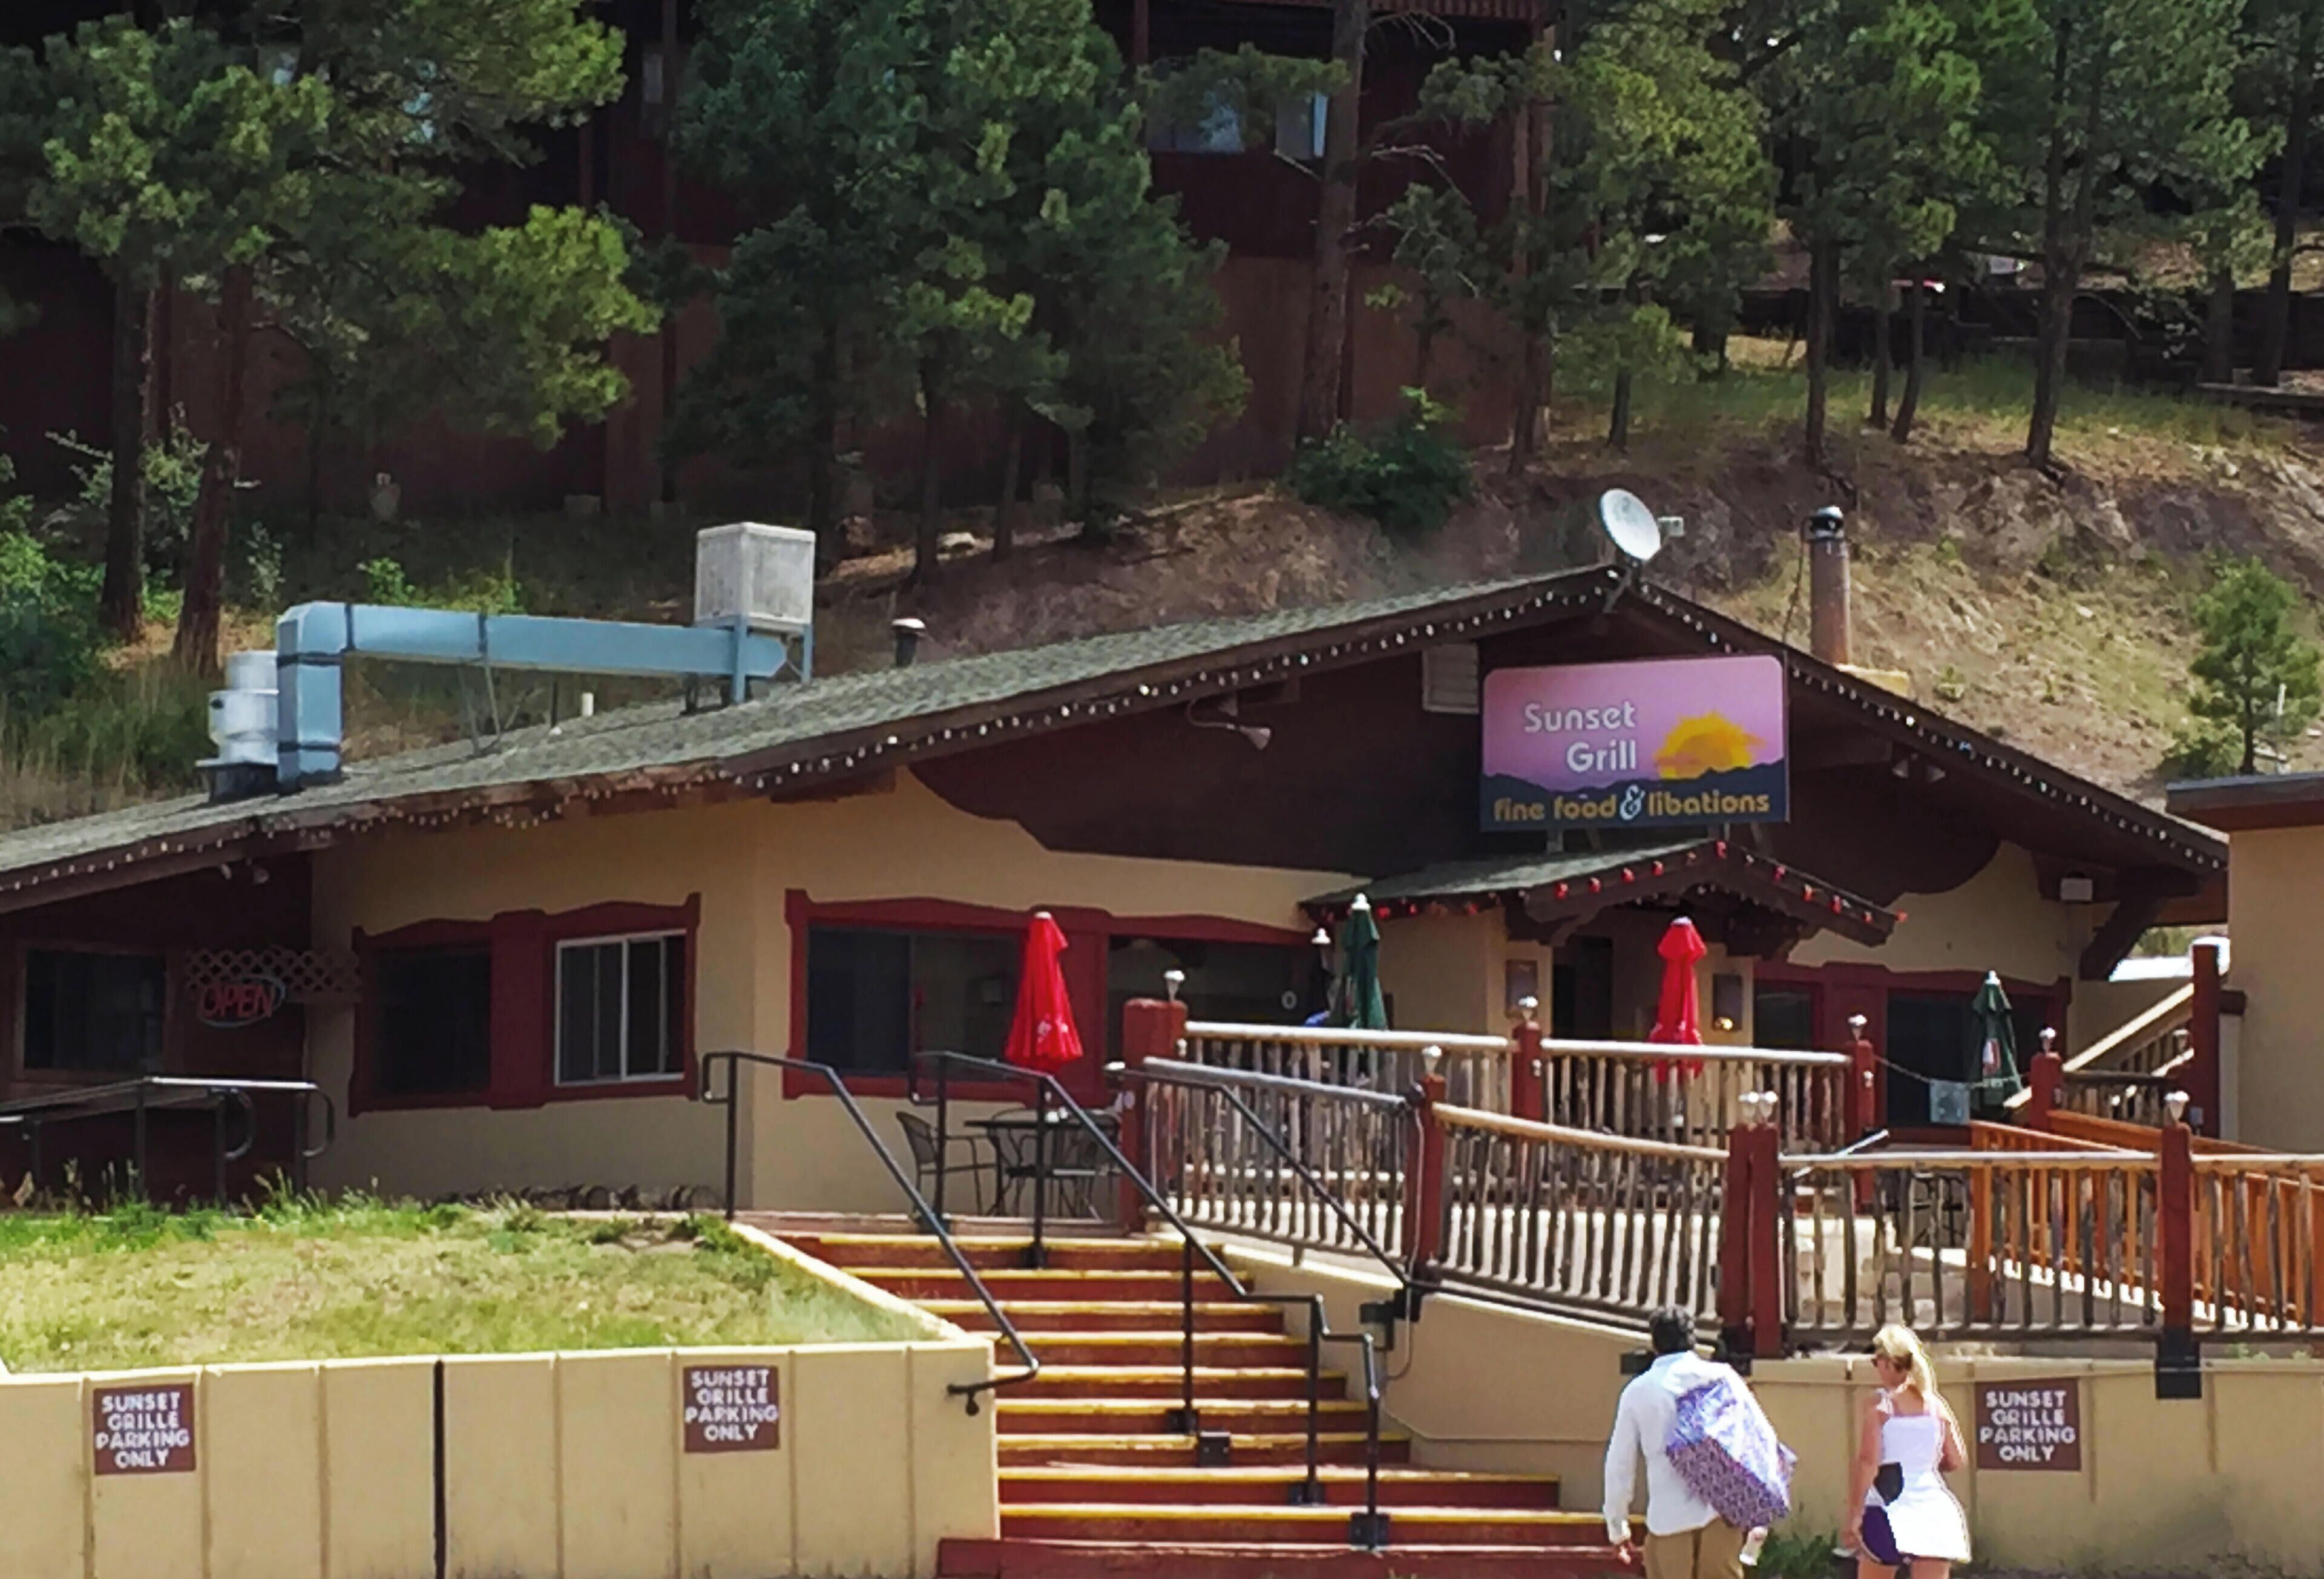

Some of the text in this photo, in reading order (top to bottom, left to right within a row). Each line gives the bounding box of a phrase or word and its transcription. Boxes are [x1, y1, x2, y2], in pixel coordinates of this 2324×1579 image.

[1523, 701, 1636, 733] Sunset
[1566, 740, 1636, 772] Grill
[1494, 785, 1770, 822] fine food & libations
[197, 982, 272, 1018] OPEN
[691, 1369, 770, 1388] SUNSET
[102, 1392, 180, 1413] SUNSET
[696, 1388, 769, 1406] GRILLE
[1986, 1391, 2067, 1408] SUNSET
[107, 1411, 180, 1431] GRILLE
[684, 1404, 779, 1424] PARKING
[1991, 1408, 2065, 1425] GRILLE
[95, 1429, 189, 1450] PARKING
[704, 1423, 758, 1442] ONLY
[1980, 1426, 2076, 1443] PARKING
[115, 1448, 168, 1469] ONLY
[1999, 1445, 2055, 1462] ONLY
